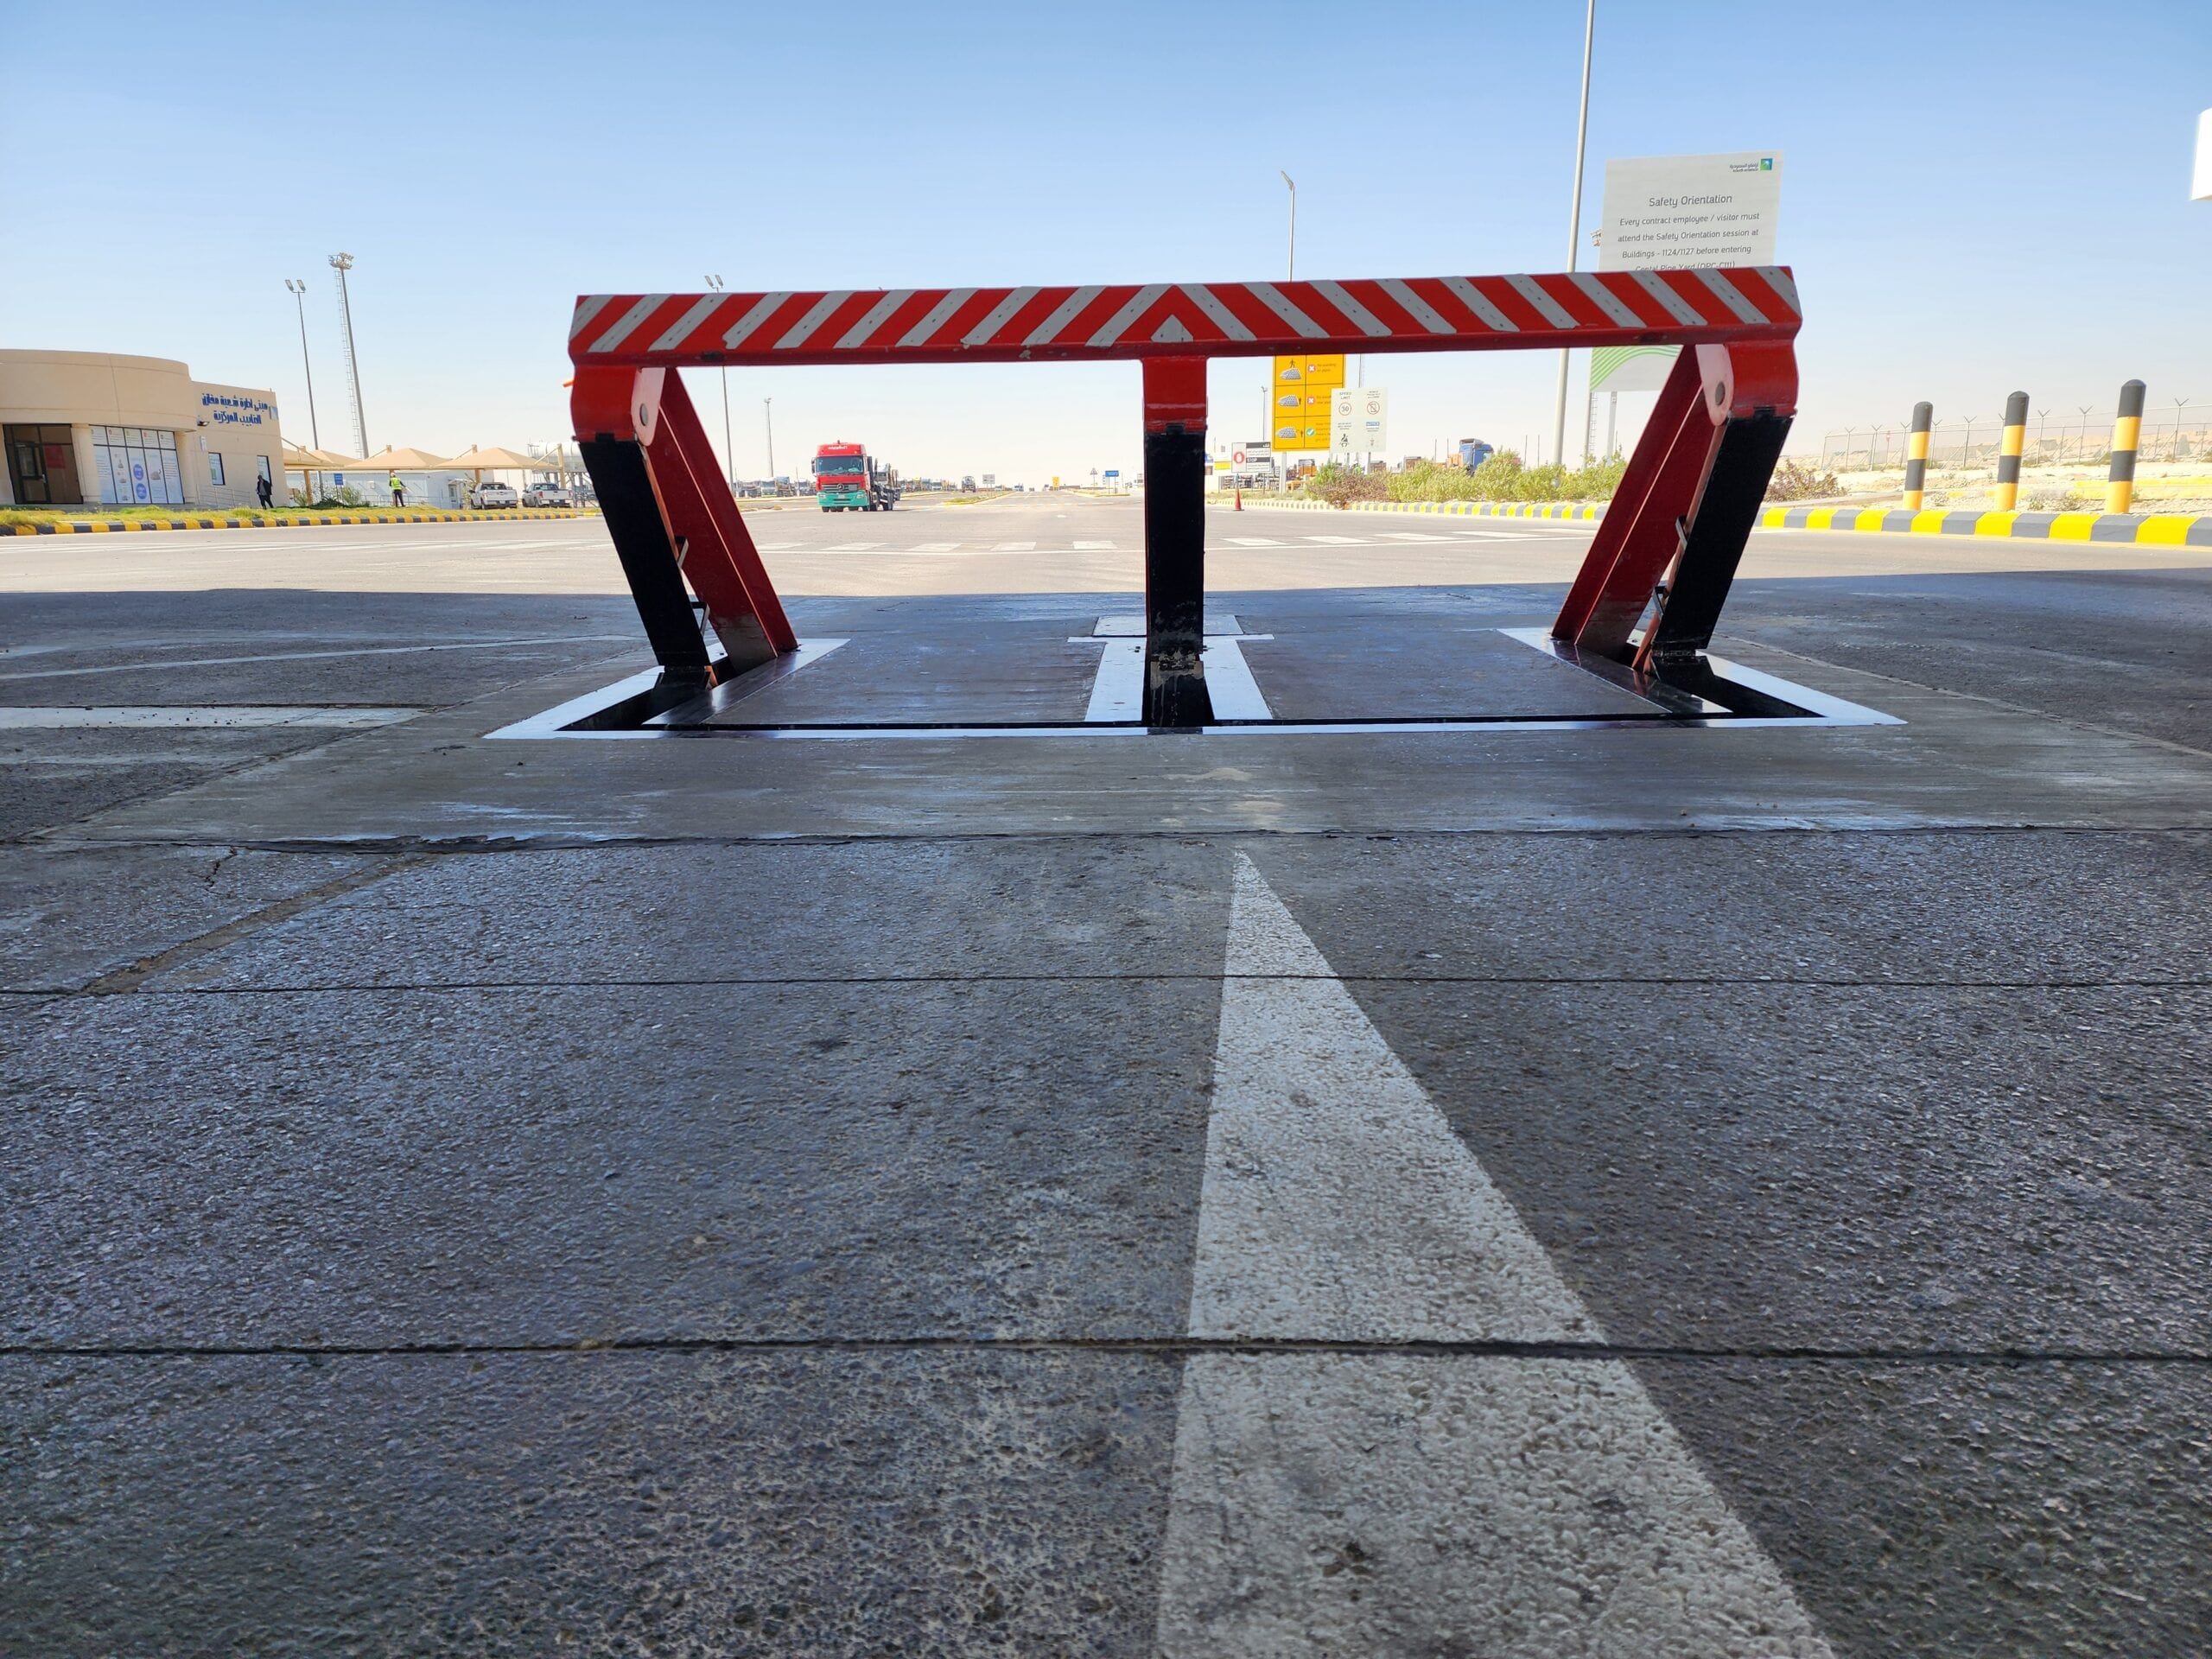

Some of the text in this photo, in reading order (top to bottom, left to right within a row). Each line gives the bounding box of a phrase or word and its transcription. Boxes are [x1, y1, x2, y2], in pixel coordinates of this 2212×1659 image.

[1649, 194, 1732, 208] Safety Orientation
[1619, 218, 1640, 227] Every
[1673, 215, 1709, 226] employee
[1618, 233, 1641, 242] attend
[1643, 232, 1654, 241] the
[1656, 232, 1679, 242] Safety
[1681, 231, 1720, 240] Orientation
[1622, 251, 1656, 259] Buildings
[1662, 248, 1694, 257] 1124/1127
[1696, 246, 1719, 255] before
[1721, 245, 1751, 255] entering
[220, 395, 239, 409] شعبة
[213, 410, 238, 424] المركزية
